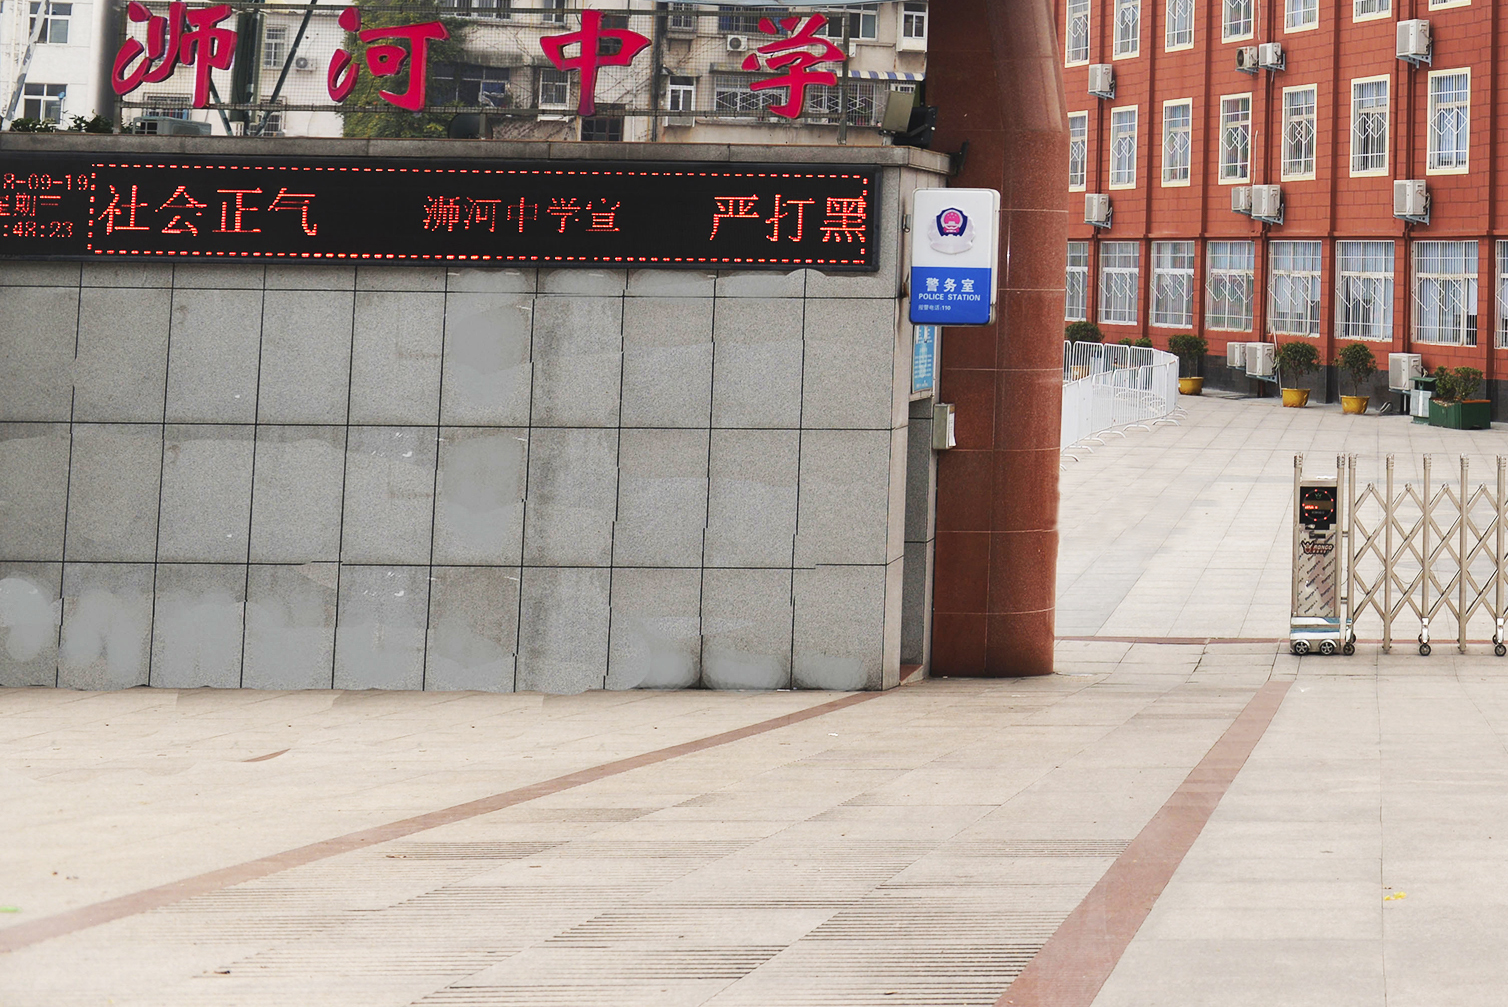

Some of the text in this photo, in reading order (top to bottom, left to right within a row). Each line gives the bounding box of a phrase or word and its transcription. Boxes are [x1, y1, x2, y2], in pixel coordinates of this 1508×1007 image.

[111, 0, 848, 120] 浉河中学
[97, 184, 318, 237] 社会正气
[709, 193, 868, 243] 严打黑
[918, 292, 981, 302] POLICE STATION
[925, 277, 975, 293] 警务室
